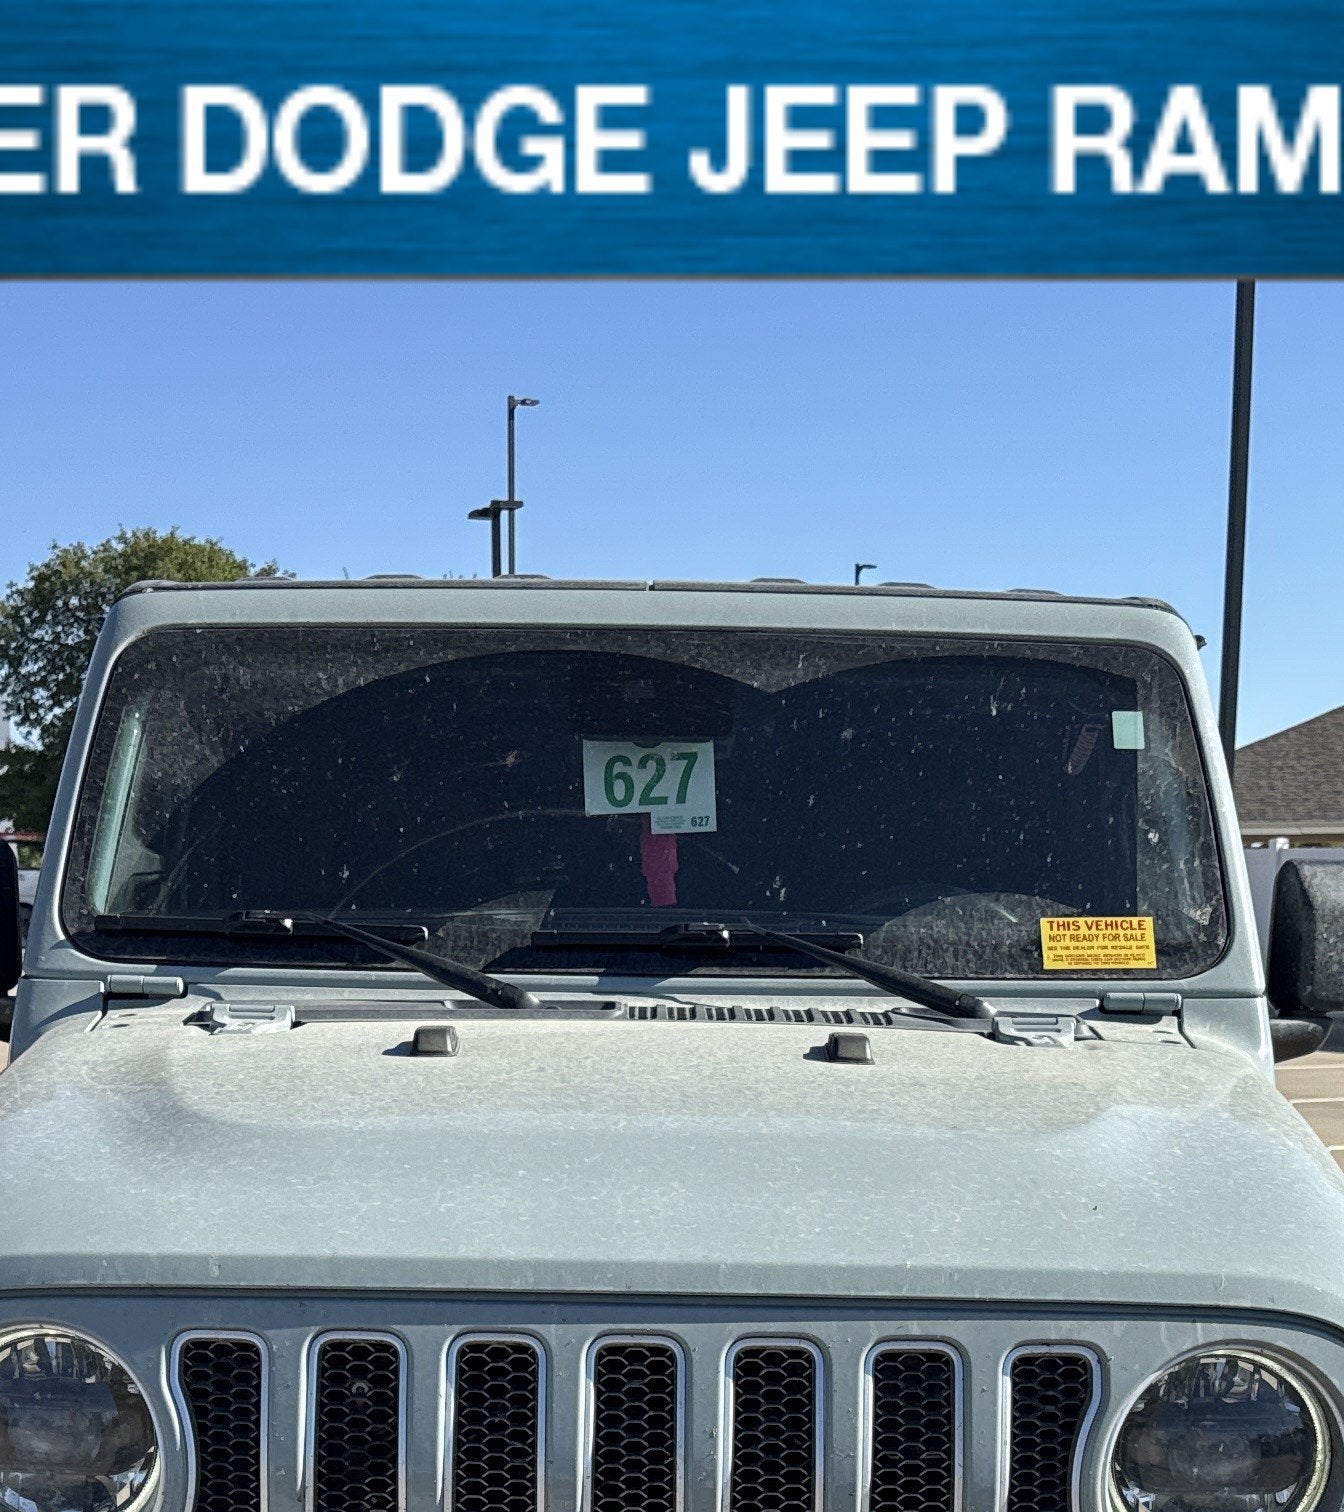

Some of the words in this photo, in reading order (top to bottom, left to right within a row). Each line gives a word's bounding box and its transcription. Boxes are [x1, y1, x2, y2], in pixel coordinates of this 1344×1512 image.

[603, 751, 699, 808] 627
[690, 815, 711, 828] 627
[1046, 919, 1081, 932] THIS
[1083, 919, 1147, 932] VEHICLE
[1048, 933, 1069, 943] NOT
[1070, 933, 1100, 943] READY
[1102, 933, 1121, 943] FOR
[1123, 932, 1146, 942] SALE
